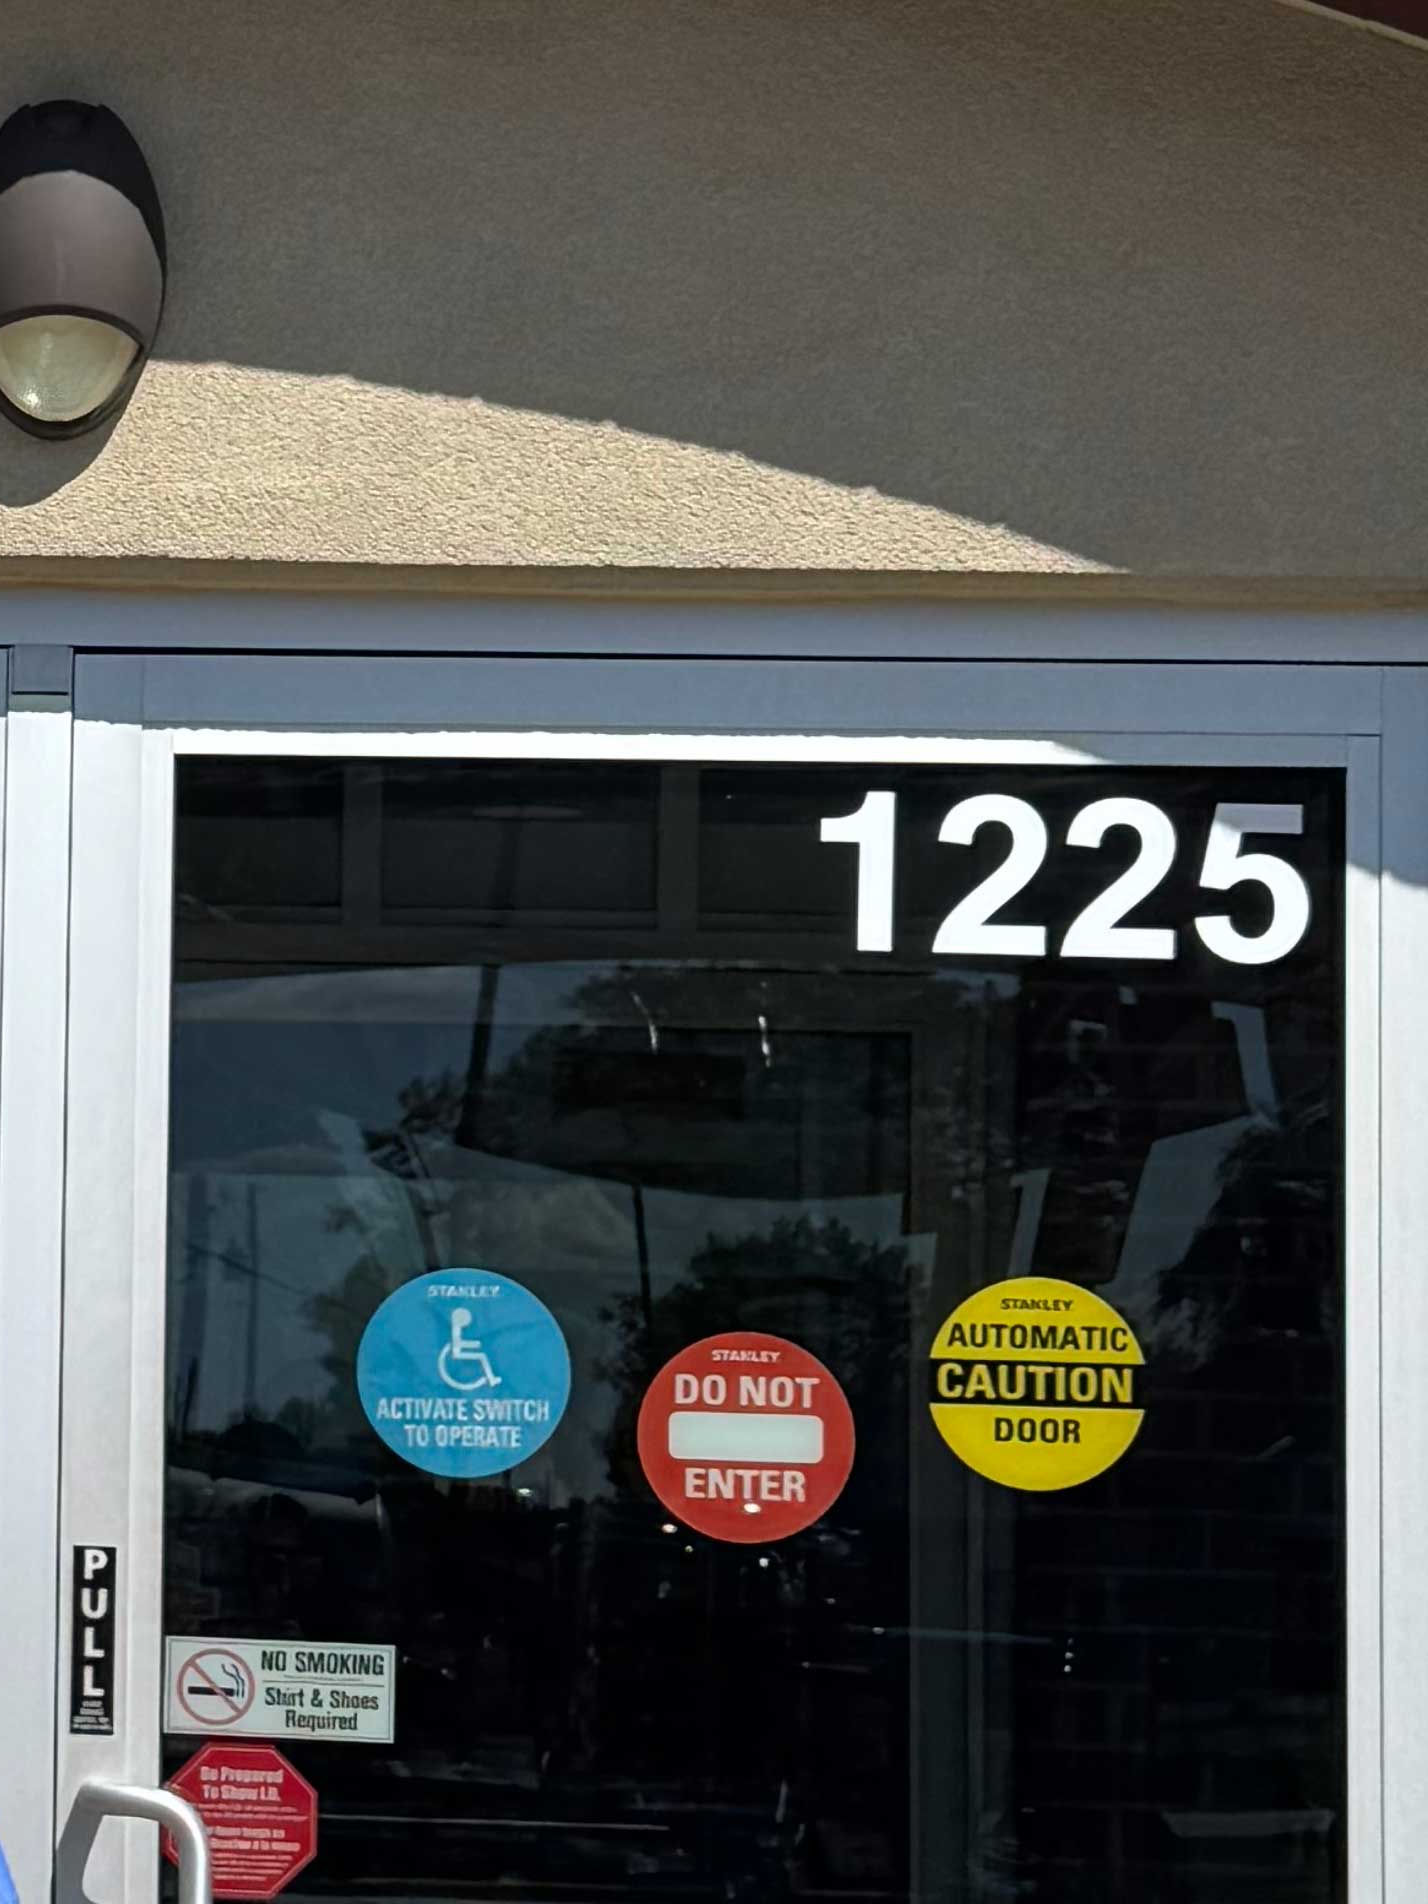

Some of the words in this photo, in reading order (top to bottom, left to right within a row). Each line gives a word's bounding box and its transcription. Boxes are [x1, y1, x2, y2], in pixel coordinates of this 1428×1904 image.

[818, 788, 1311, 966] 1225
[427, 1285, 501, 1298] STANLEY
[1000, 1298, 1074, 1312] STANLEY
[947, 1323, 1128, 1352] AUTOMATIC
[711, 1349, 782, 1363] STANLEY
[674, 1373, 727, 1406] DO
[739, 1375, 821, 1409] NOT
[936, 1362, 1134, 1404] CAUTION
[376, 1397, 468, 1420] ACTIVATE
[473, 1398, 550, 1423] SWITCH
[403, 1424, 428, 1447] TO
[434, 1425, 522, 1448] OPERATE
[993, 1417, 1081, 1444] DOOR
[684, 1467, 806, 1503] ENTER
[80, 1549, 108, 1697] PULL
[261, 1650, 287, 1672] NO
[295, 1651, 385, 1676] SMOKING
[264, 1687, 305, 1708] Shirt
[310, 1688, 324, 1708] &
[329, 1690, 380, 1711] Shoes
[285, 1709, 358, 1732] Required
[220, 1765, 284, 1783] Prepared
[203, 1784, 219, 1799] To
